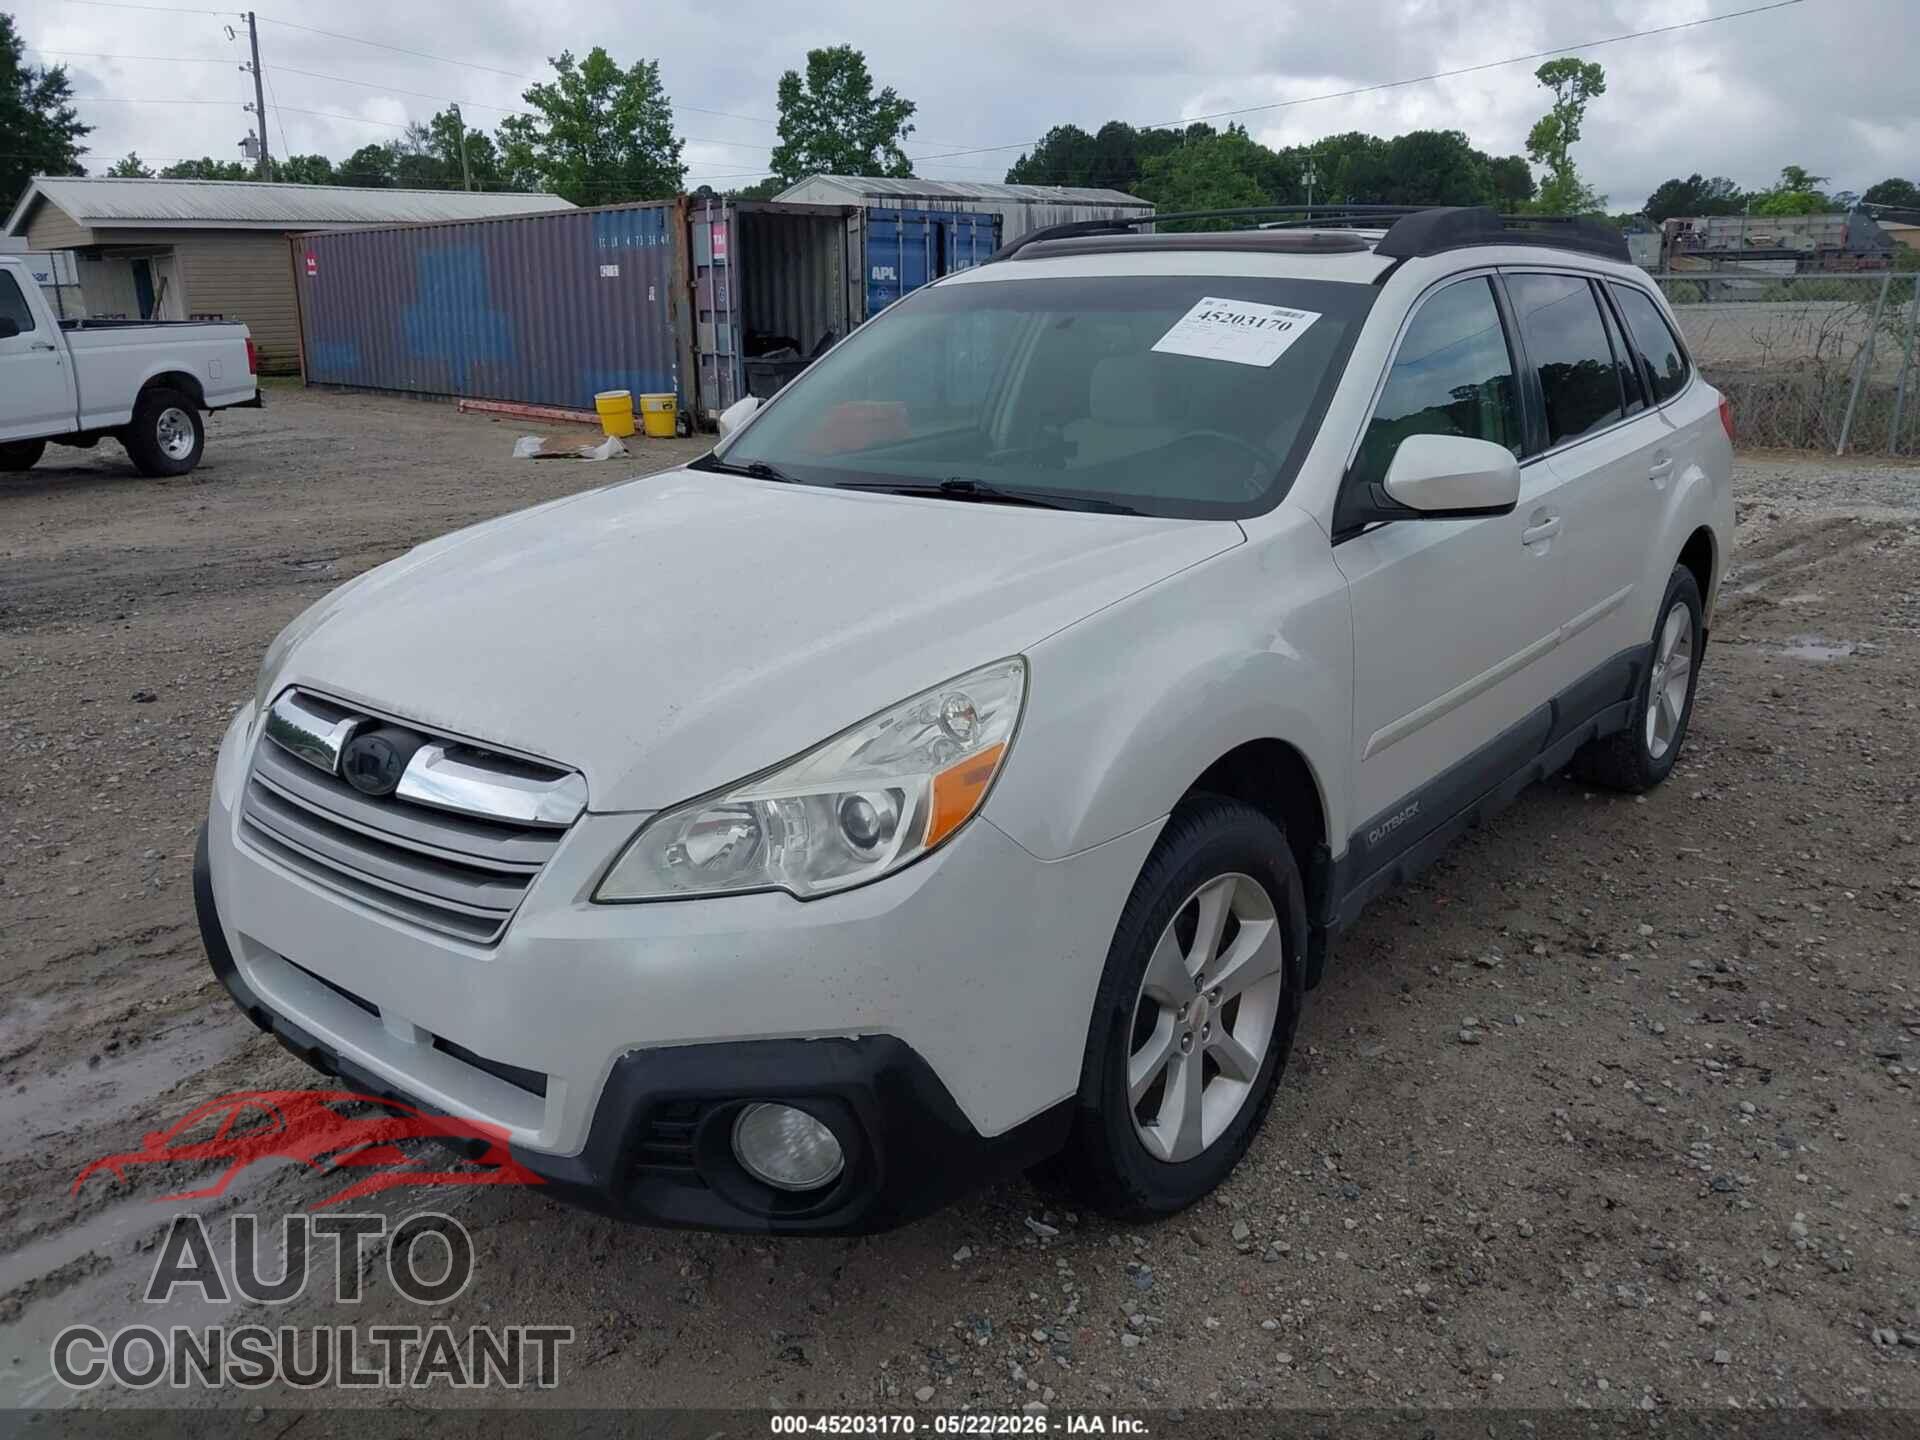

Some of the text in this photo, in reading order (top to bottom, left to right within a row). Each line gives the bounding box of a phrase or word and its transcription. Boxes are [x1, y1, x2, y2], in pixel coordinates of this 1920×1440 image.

[872, 266, 897, 280] APL
[1198, 310, 1293, 331] 45203170
[1368, 800, 1421, 843] OUTBACK
